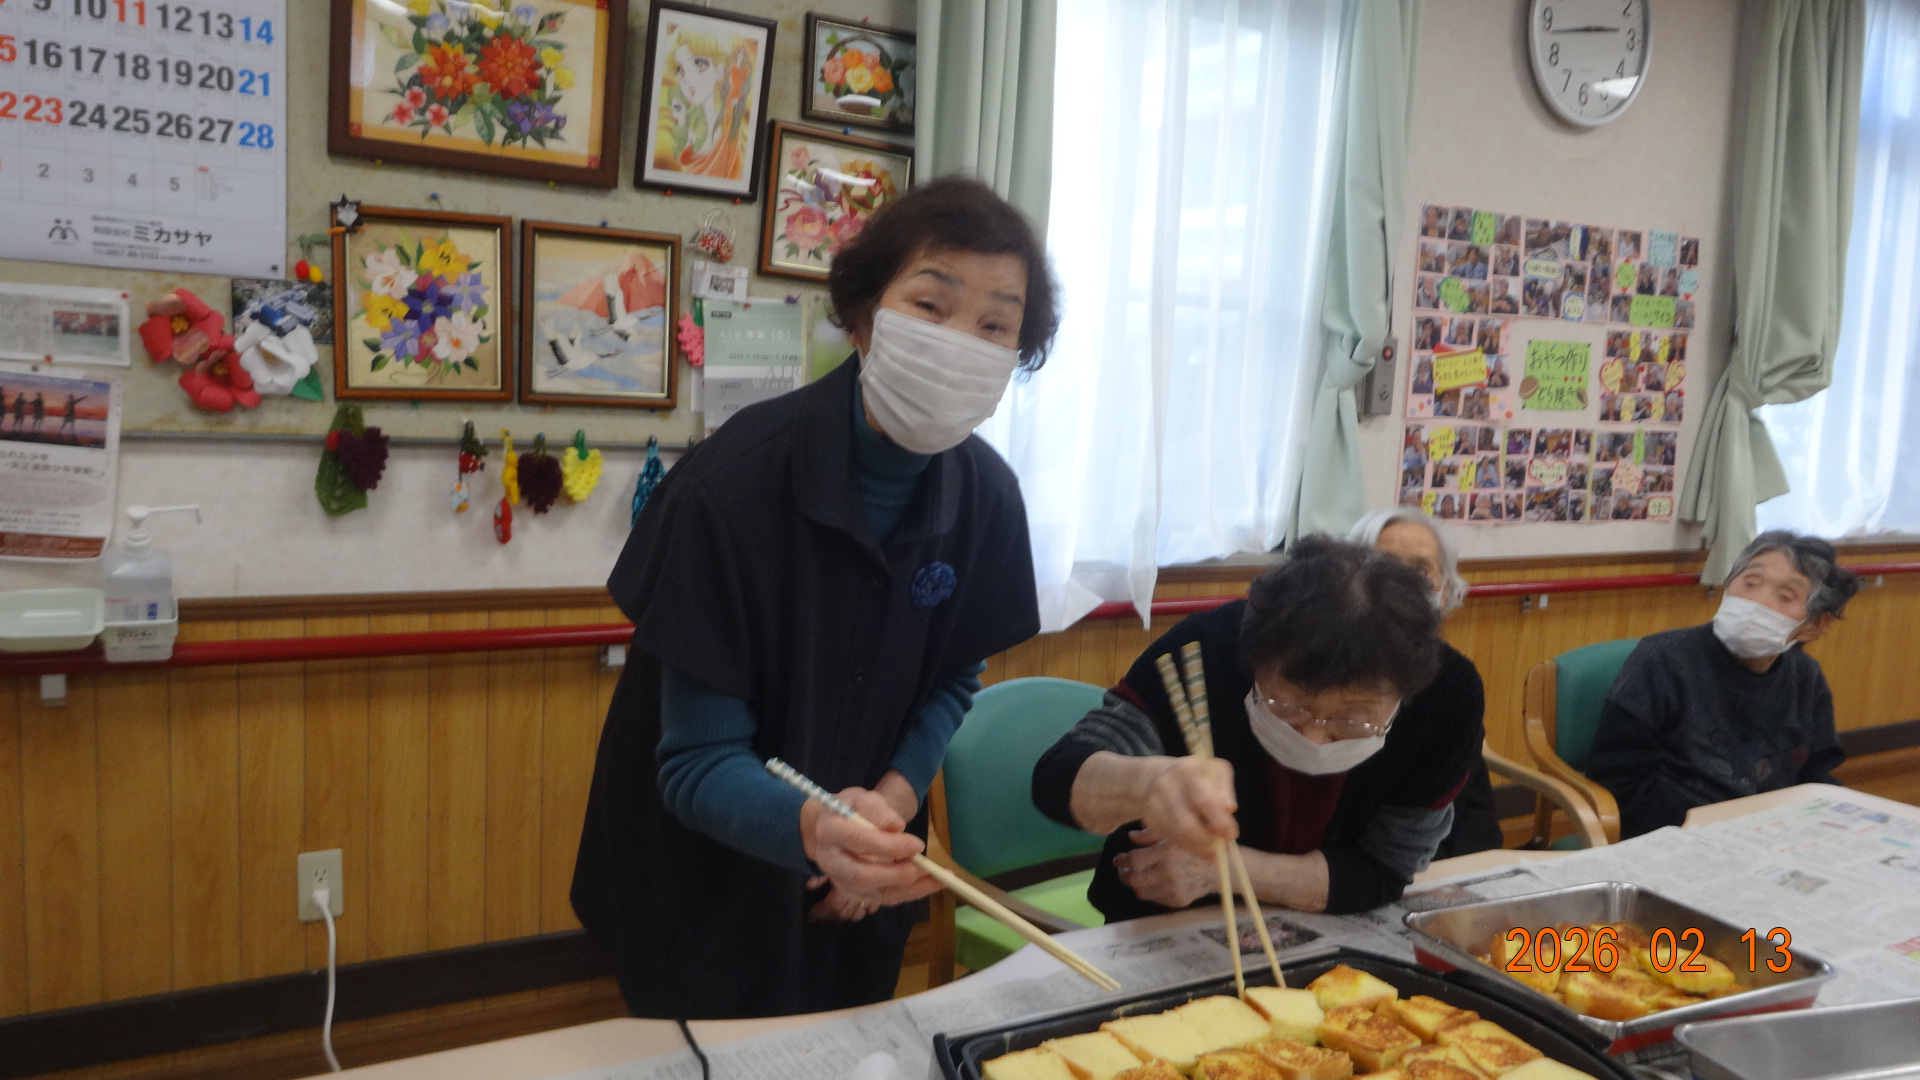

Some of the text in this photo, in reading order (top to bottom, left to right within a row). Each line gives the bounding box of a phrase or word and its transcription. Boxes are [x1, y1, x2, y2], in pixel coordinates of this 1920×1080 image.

[73, 0, 274, 45] 10 11 12 13 14
[1543, 6, 1553, 31] 9
[1626, 27, 1636, 52] 3
[1548, 42, 1560, 67] 8
[24, 38, 63, 68] 16
[69, 45, 107, 74] 17
[114, 52, 151, 81] 18
[156, 57, 193, 86] 19
[198, 63, 234, 92] 20
[238, 68, 271, 97] 21
[1616, 58, 1625, 79] 4
[1562, 68, 1572, 93] 7
[1578, 82, 1589, 106] 6
[23, 94, 63, 124] 23
[69, 100, 107, 129] 24
[113, 106, 150, 135] 25
[156, 111, 193, 139] 26
[198, 117, 234, 144] 27
[238, 121, 274, 149] 28
[38, 163, 180, 192] 2 3 4 5
[134, 225, 212, 247] ミカサヤ
[1529, 346, 1588, 373] おやつ作り
[1538, 384, 1577, 405] どら焼き
